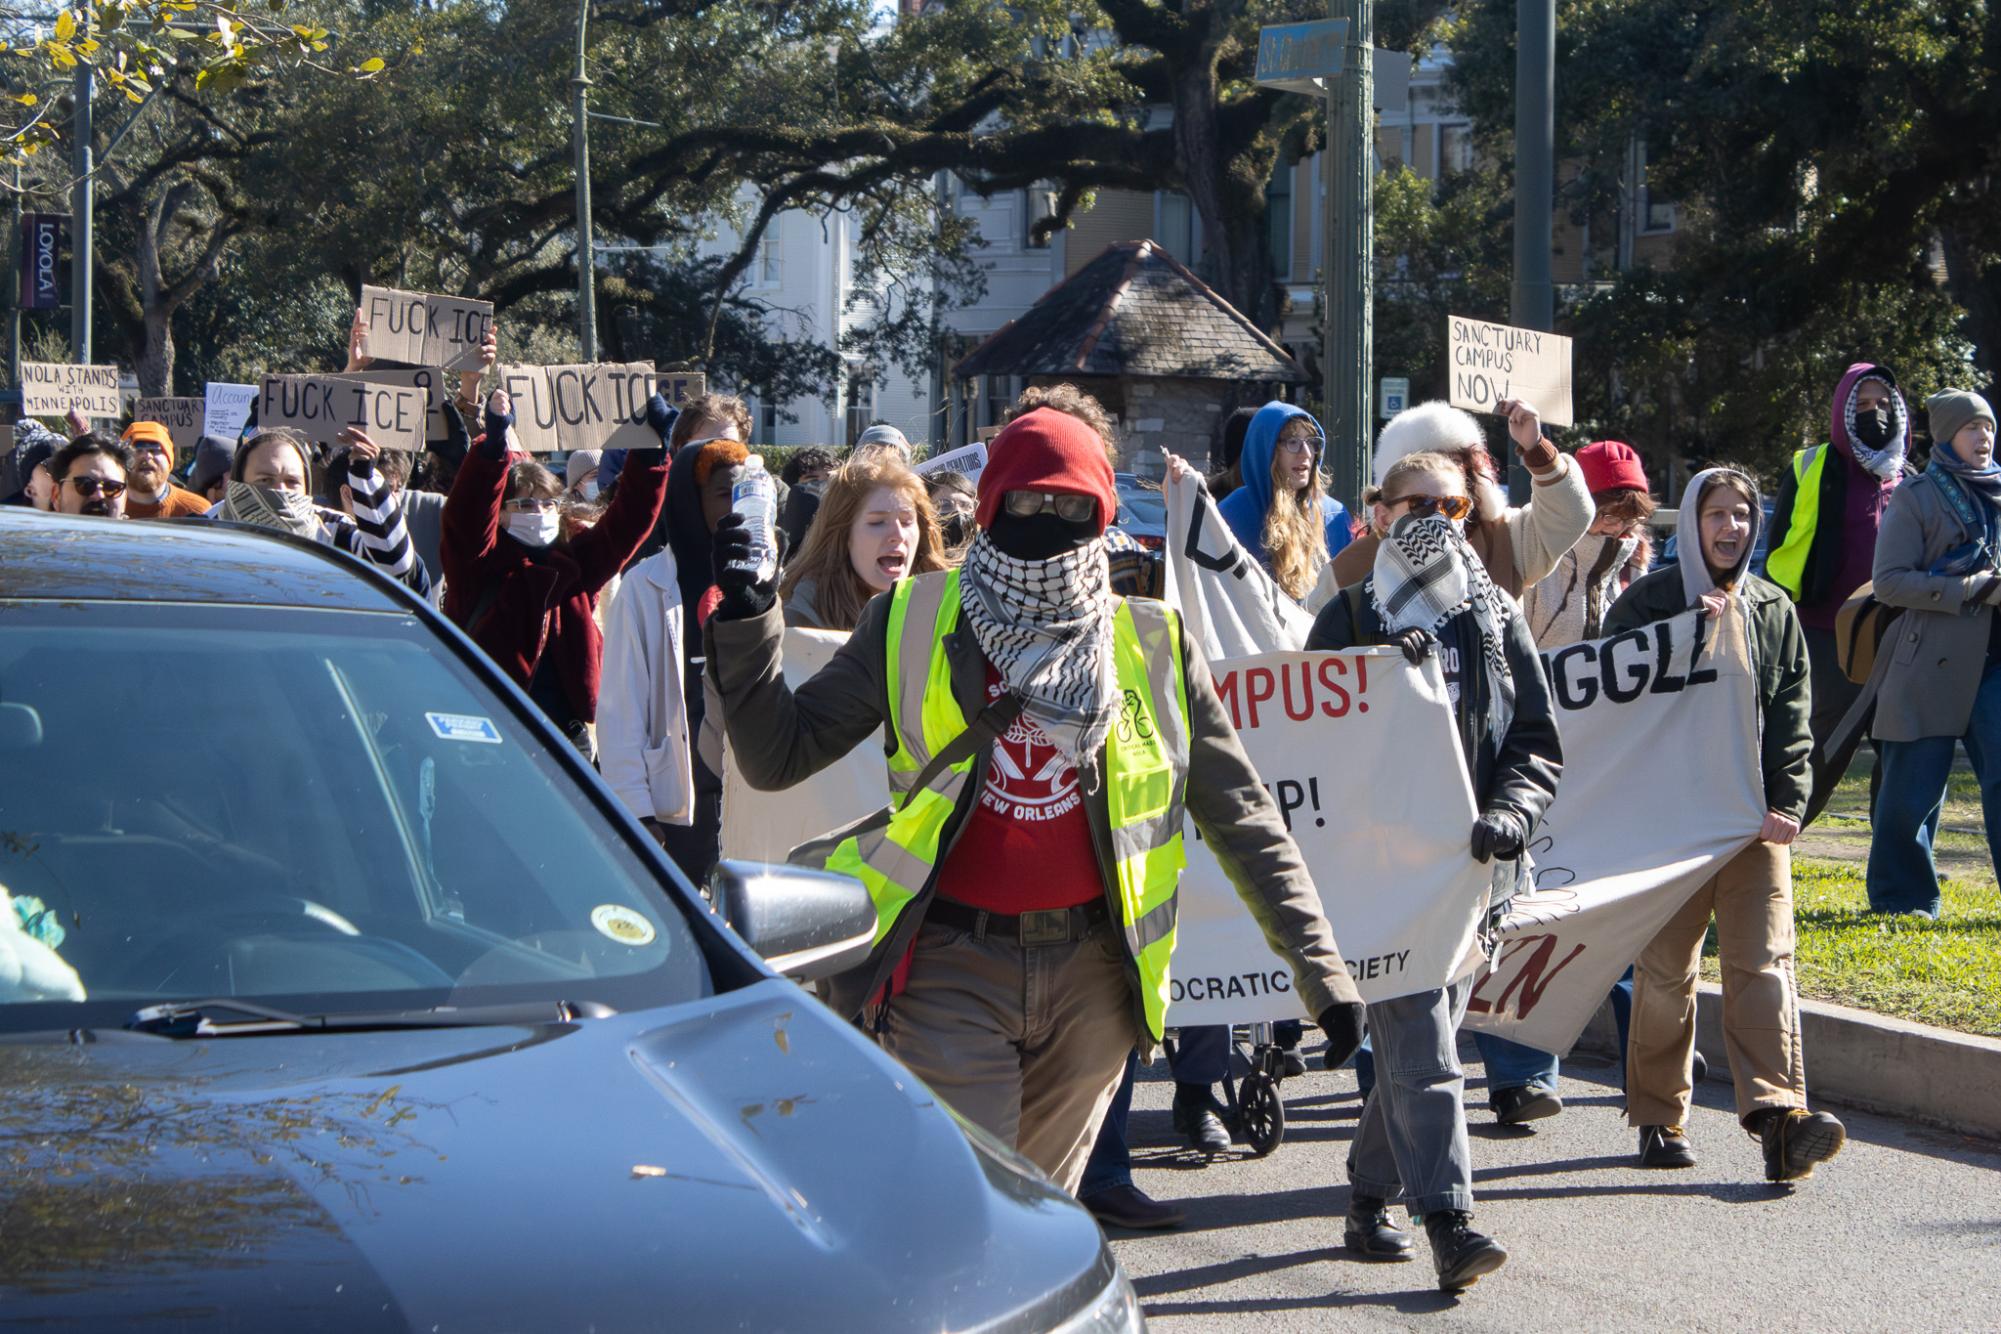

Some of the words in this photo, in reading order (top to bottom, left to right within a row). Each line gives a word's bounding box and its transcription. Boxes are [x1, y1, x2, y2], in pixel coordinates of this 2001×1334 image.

[39, 223, 54, 291] LOYOLA
[370, 297, 440, 339] FUCK
[449, 308, 492, 346] ICE
[1453, 320, 1541, 355] SANCTUARY
[1455, 345, 1513, 373] CAMPUS
[23, 365, 61, 383] NOLA
[67, 366, 117, 389] STANDS
[58, 384, 84, 394] WITH
[26, 396, 117, 413] MINNEAPOLIS
[139, 399, 204, 413] SANCTUAR
[264, 378, 337, 423] FUCK
[347, 388, 413, 433] ICE
[506, 370, 603, 430] FUCK
[1210, 655, 1370, 730] MPUS!
[1014, 791, 1082, 822] ORLEANS
[1169, 970, 1291, 1002] OCRATIC
[1345, 949, 1411, 983] CIETY
